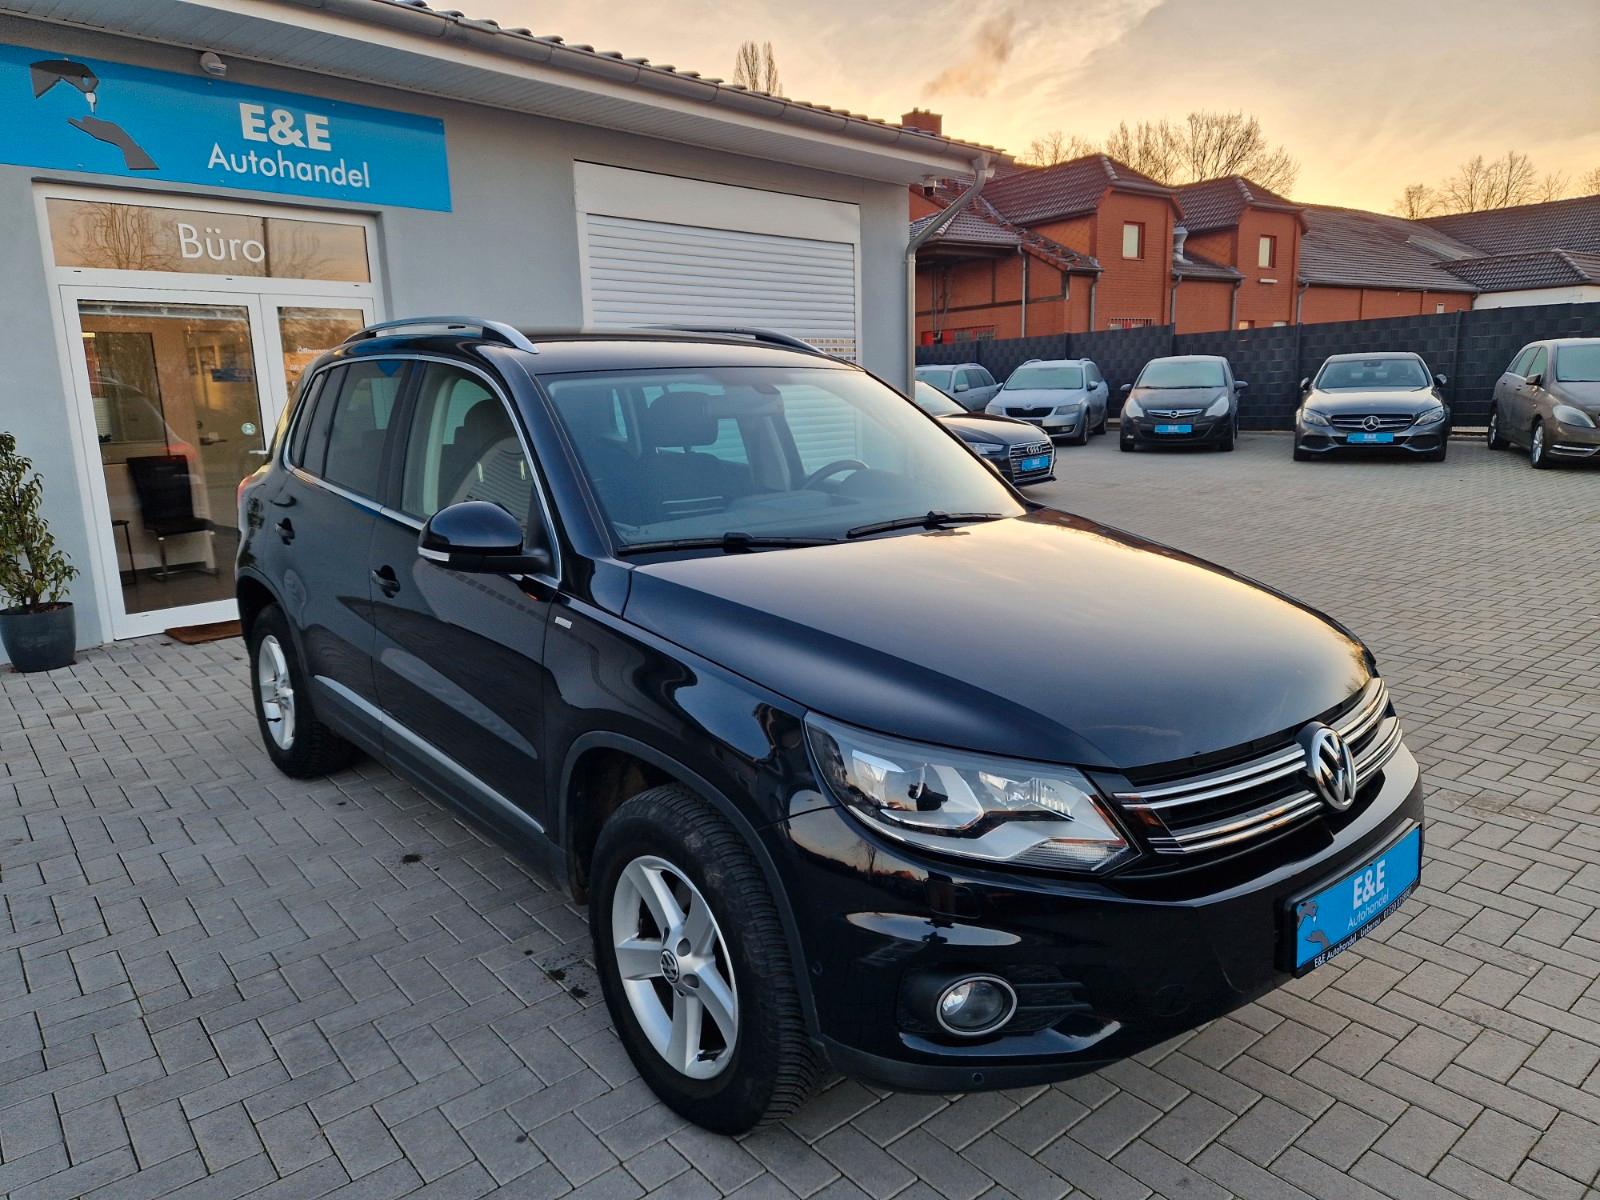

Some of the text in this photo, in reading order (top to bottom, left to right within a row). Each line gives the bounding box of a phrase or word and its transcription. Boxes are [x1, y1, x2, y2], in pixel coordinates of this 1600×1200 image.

[240, 103, 332, 151] E&E
[208, 143, 370, 189] Autohandel
[178, 223, 265, 263] Büro
[1353, 860, 1386, 910] E&E
[1347, 888, 1390, 931] Autohandel
[1314, 953, 1326, 968] E&E
[1326, 933, 1357, 960] Autohandel
